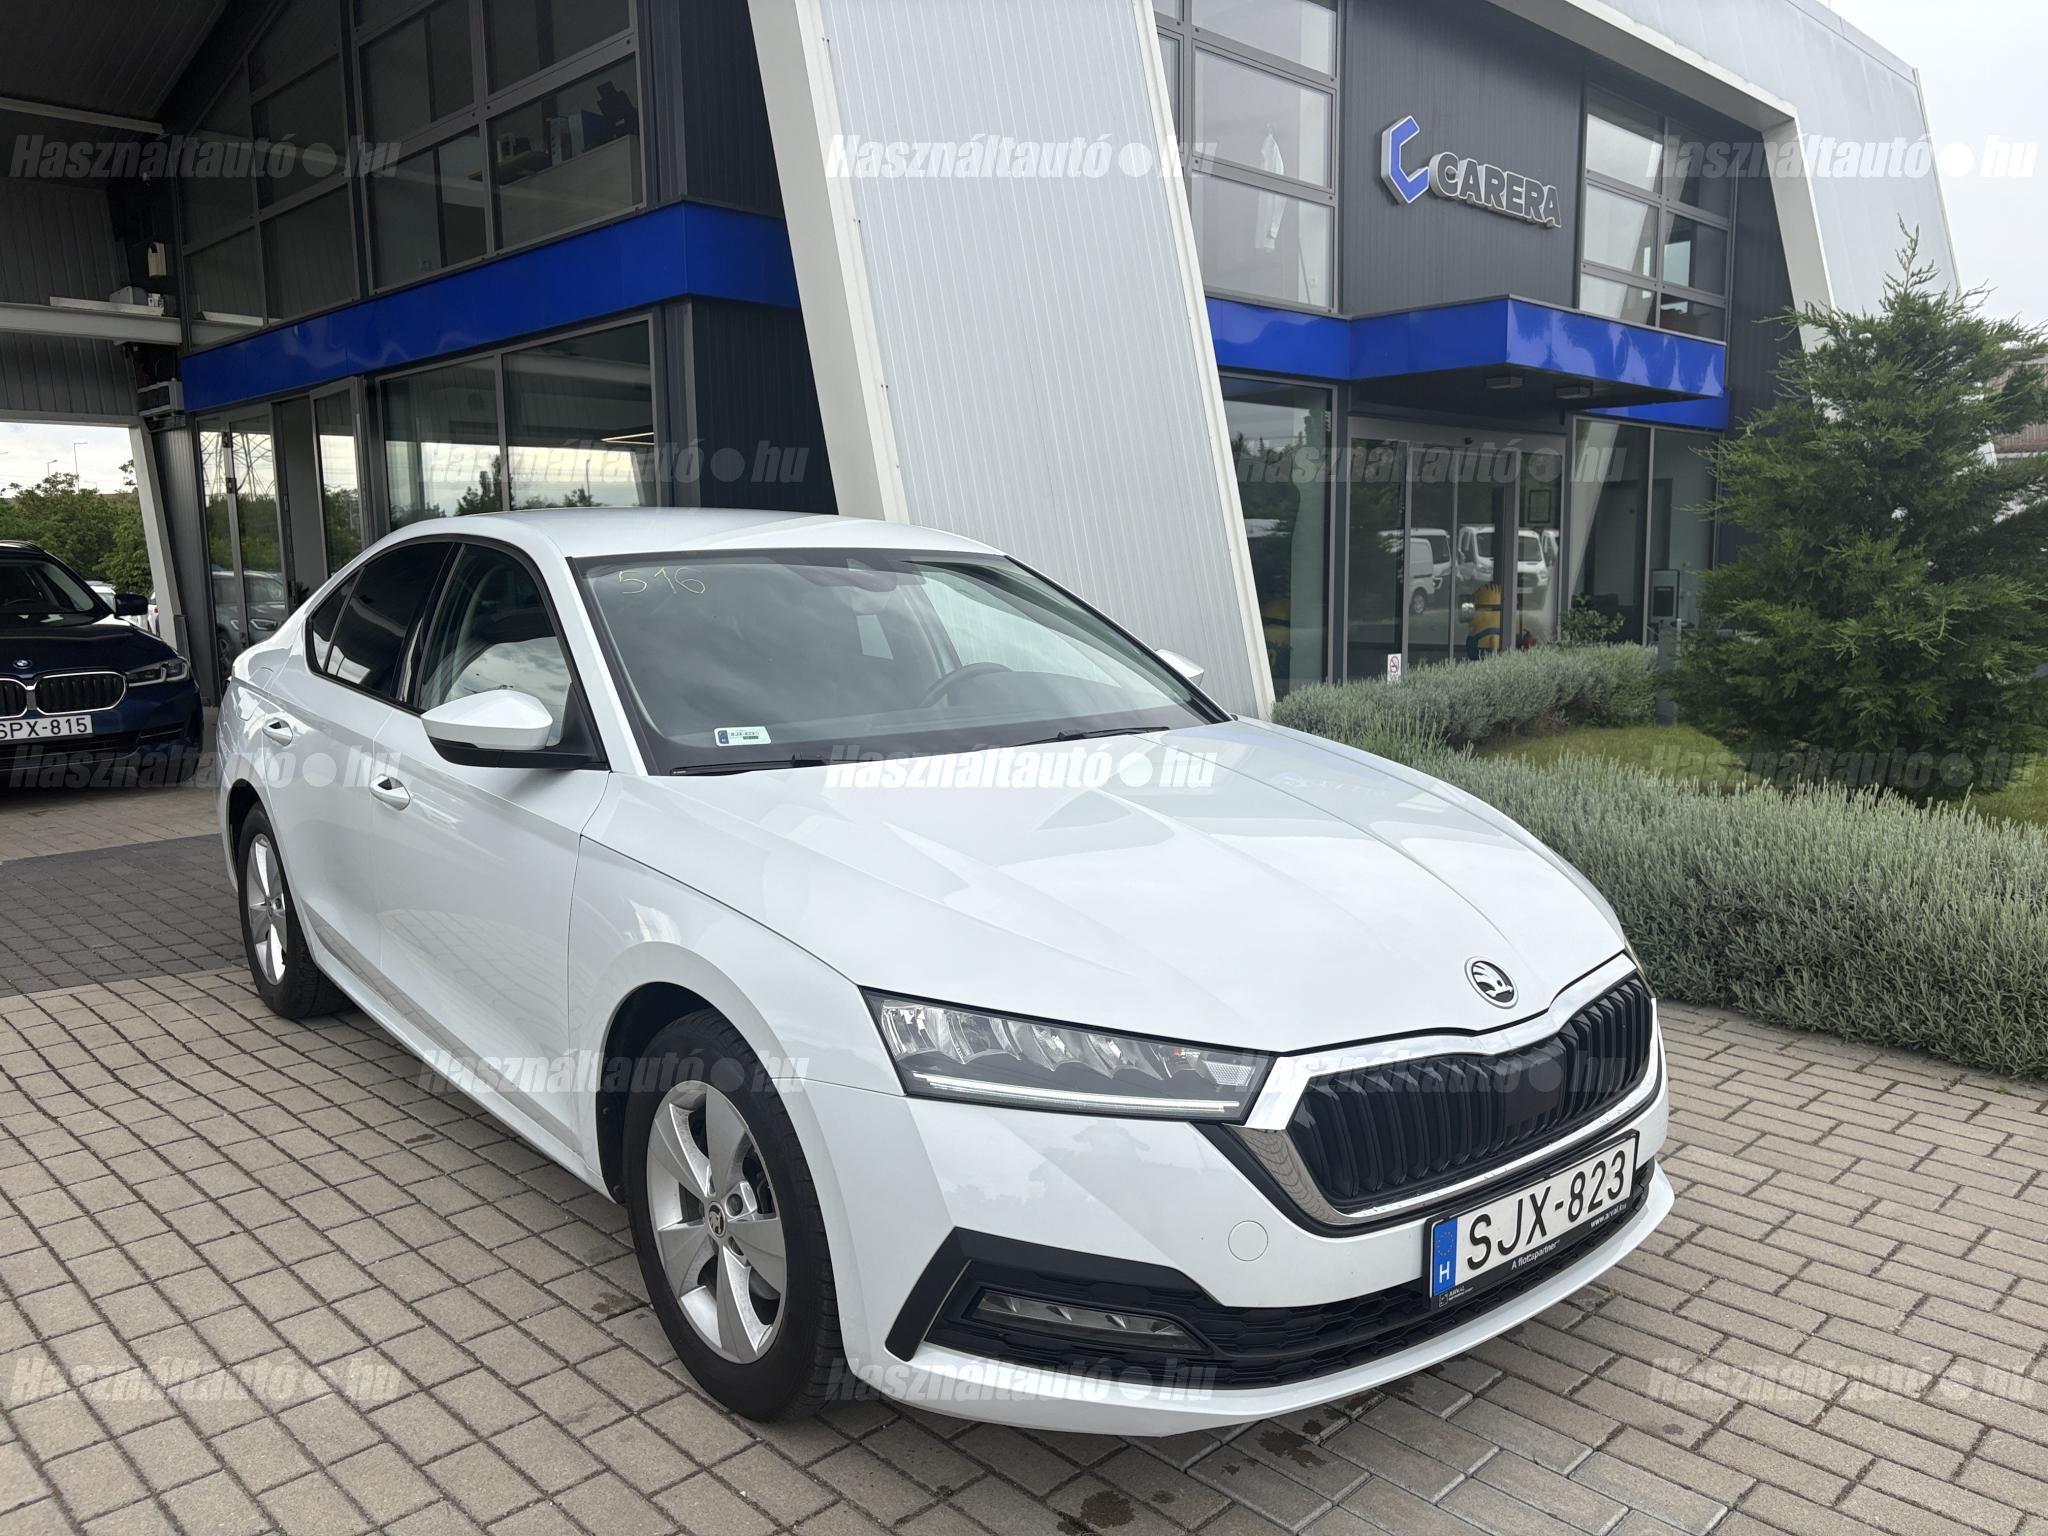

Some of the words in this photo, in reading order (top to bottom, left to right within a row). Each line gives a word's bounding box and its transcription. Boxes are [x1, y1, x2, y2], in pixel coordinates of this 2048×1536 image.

[1429, 152, 1562, 228] CARERA
[618, 566, 706, 594] 516
[1467, 1150, 1626, 1271] SJX-823
[1439, 1261, 1450, 1283] H
